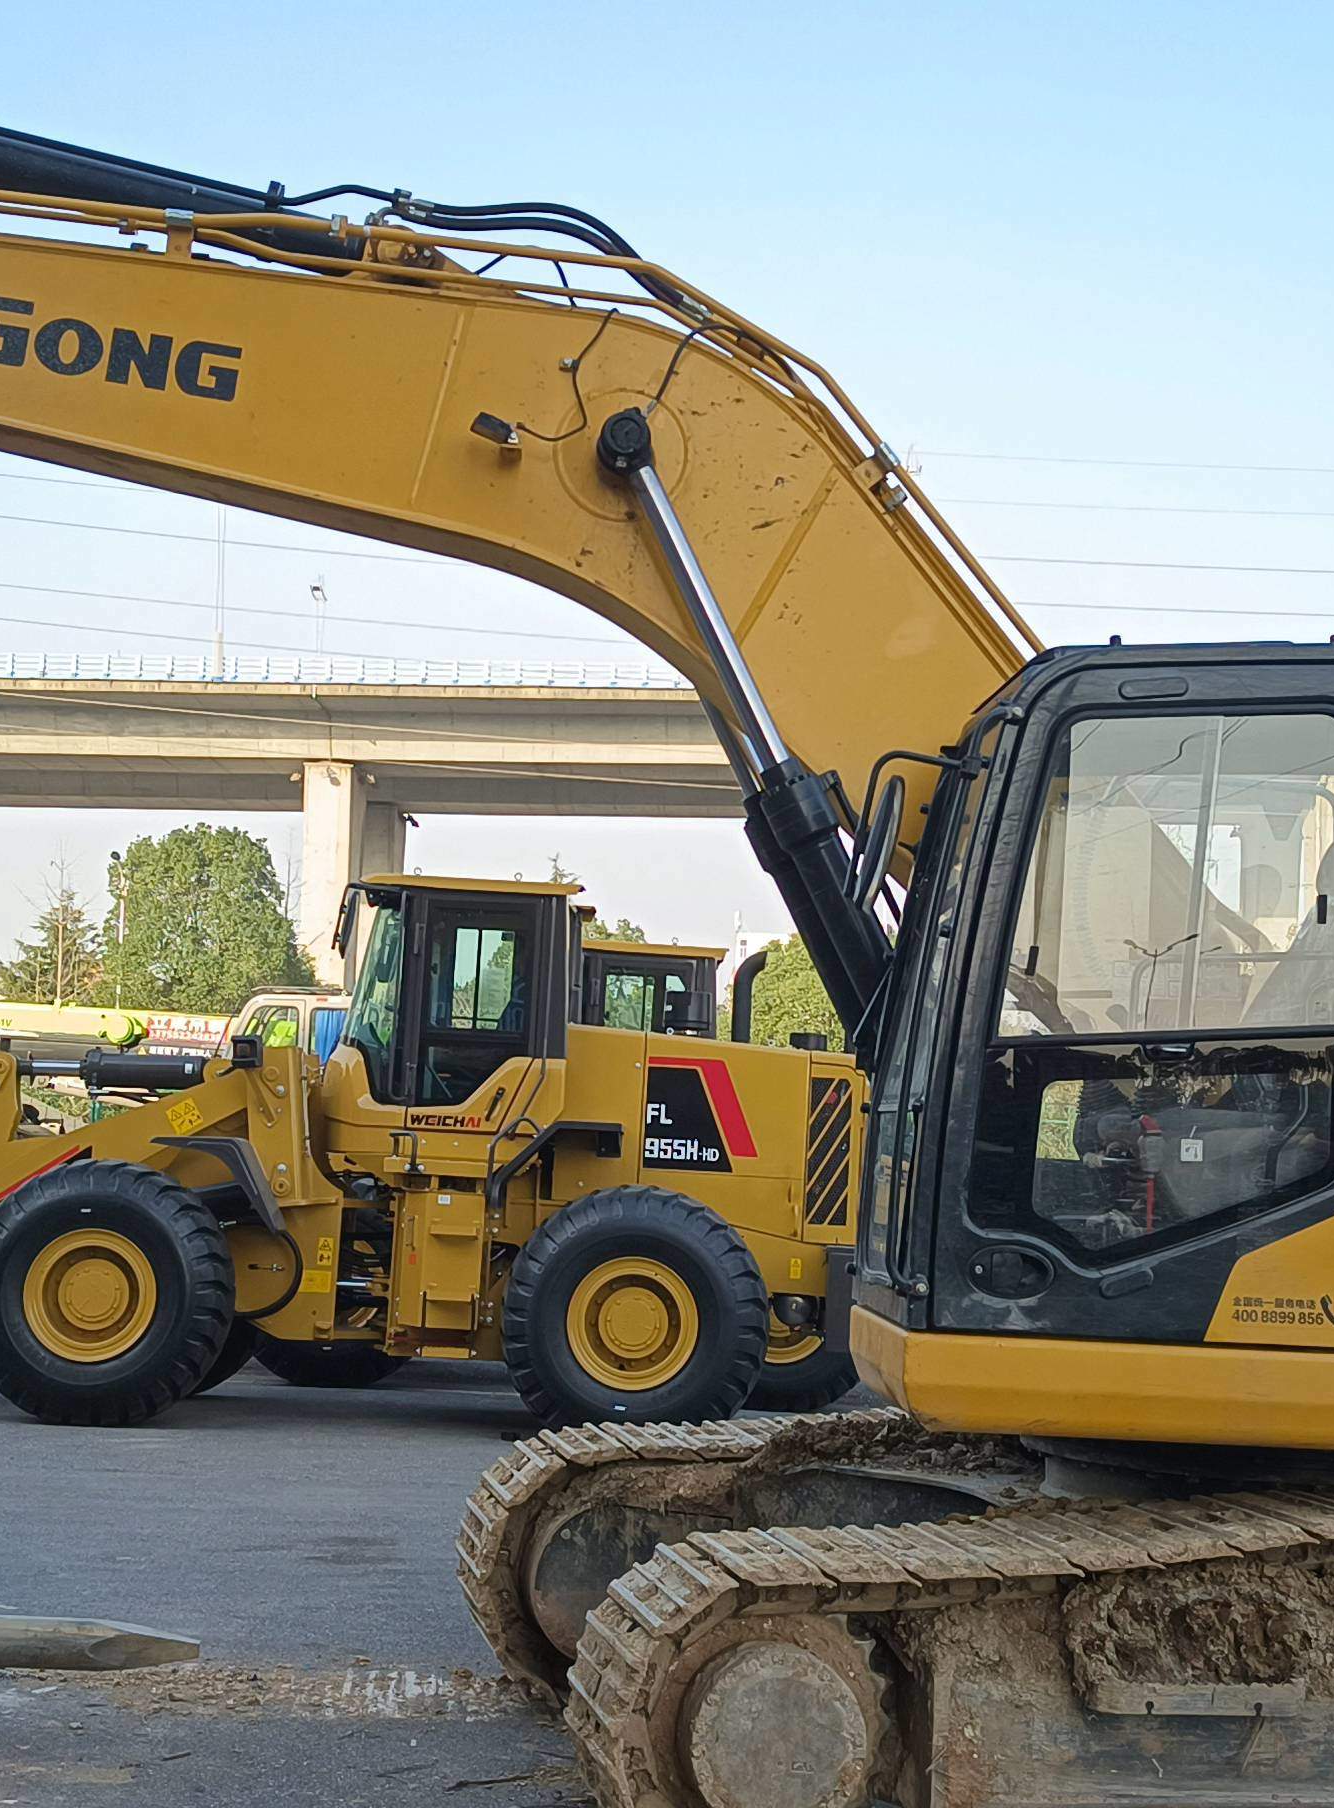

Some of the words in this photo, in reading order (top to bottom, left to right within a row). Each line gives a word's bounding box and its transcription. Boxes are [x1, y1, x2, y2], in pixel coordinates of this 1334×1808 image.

[410, 1113, 482, 1129] WEICHAI
[646, 1103, 673, 1125] FL
[644, 1137, 720, 1162] 955H-HD
[1231, 1309, 1259, 1323] 400
[1261, 1310, 1296, 1325] 8899
[1297, 1312, 1324, 1326] 856
